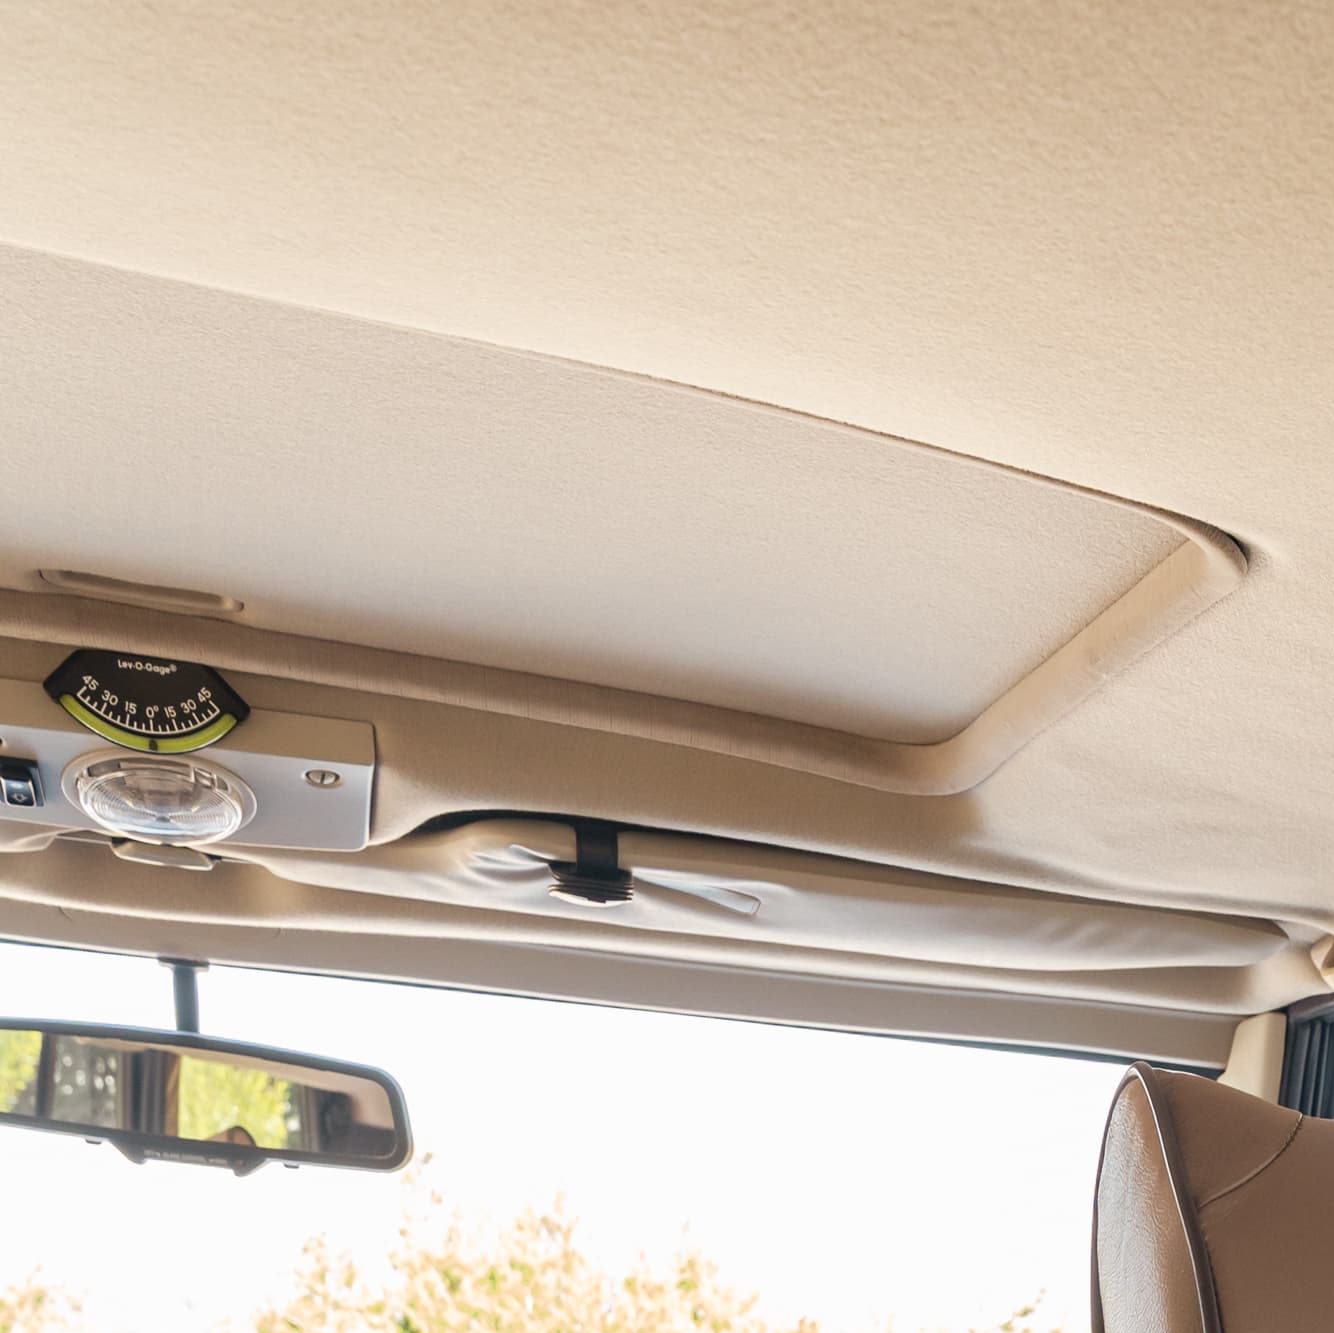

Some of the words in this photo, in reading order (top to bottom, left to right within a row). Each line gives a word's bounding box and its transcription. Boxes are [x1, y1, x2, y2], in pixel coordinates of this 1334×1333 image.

[81, 674, 99, 691] 45
[102, 690, 119, 706] 30
[125, 701, 137, 714] 15
[164, 706, 176, 718] 15
[181, 699, 197, 714] 30
[198, 687, 212, 702] 45
